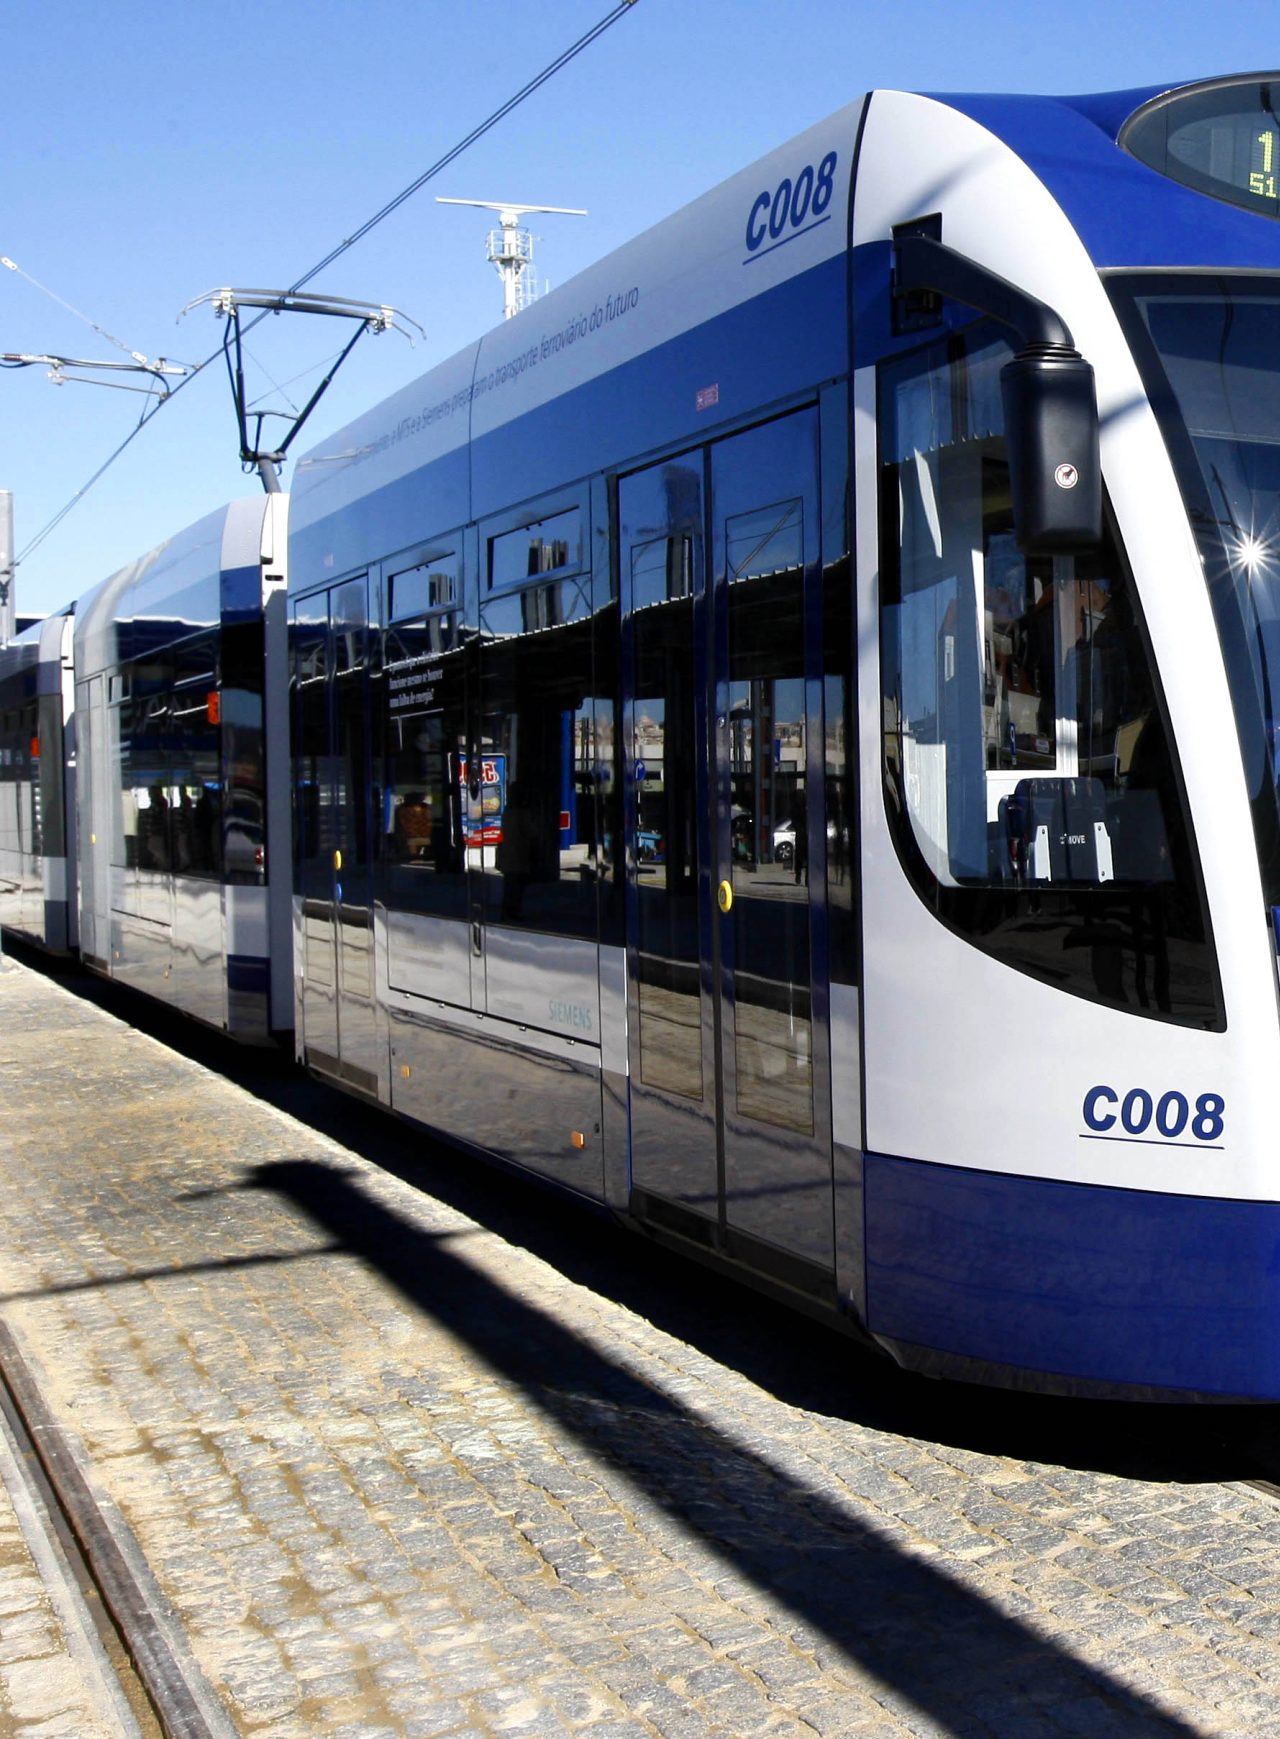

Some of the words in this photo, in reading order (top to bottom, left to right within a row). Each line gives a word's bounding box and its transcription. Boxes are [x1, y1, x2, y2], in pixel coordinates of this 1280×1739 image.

[1257, 131, 1273, 172] 1
[745, 150, 838, 252] C008
[495, 345, 538, 385] transporte
[539, 312, 588, 362] ferroviário
[589, 303, 603, 333] do
[605, 286, 639, 323] futuro
[548, 1000, 593, 1030] SIEMENS
[1082, 1085, 1226, 1141] C008
